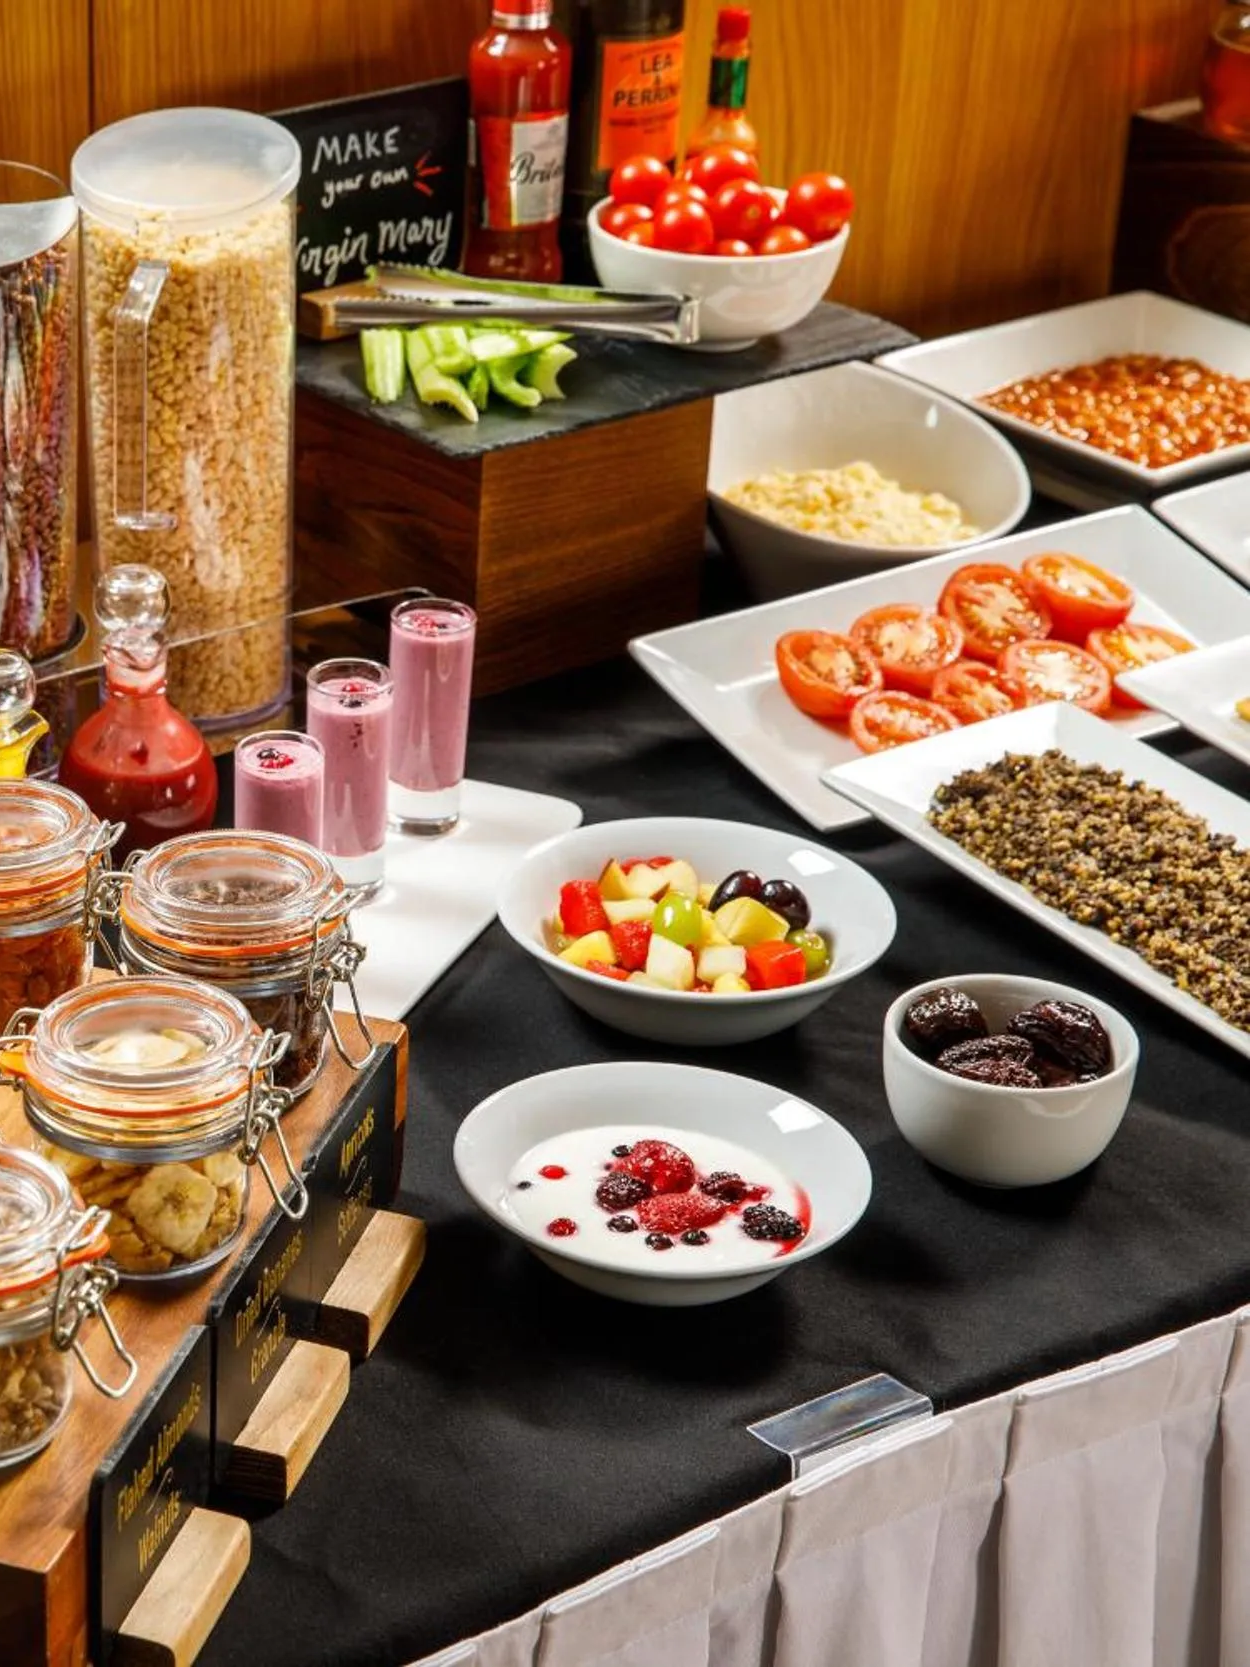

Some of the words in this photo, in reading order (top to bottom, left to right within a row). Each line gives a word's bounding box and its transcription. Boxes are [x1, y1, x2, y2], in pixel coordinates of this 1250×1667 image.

[640, 52, 674, 75] LEA
[613, 82, 680, 108] PERRIN
[311, 125, 401, 174] MAKE
[320, 173, 364, 209] your
[370, 165, 409, 189] own
[378, 210, 453, 266] Mary
